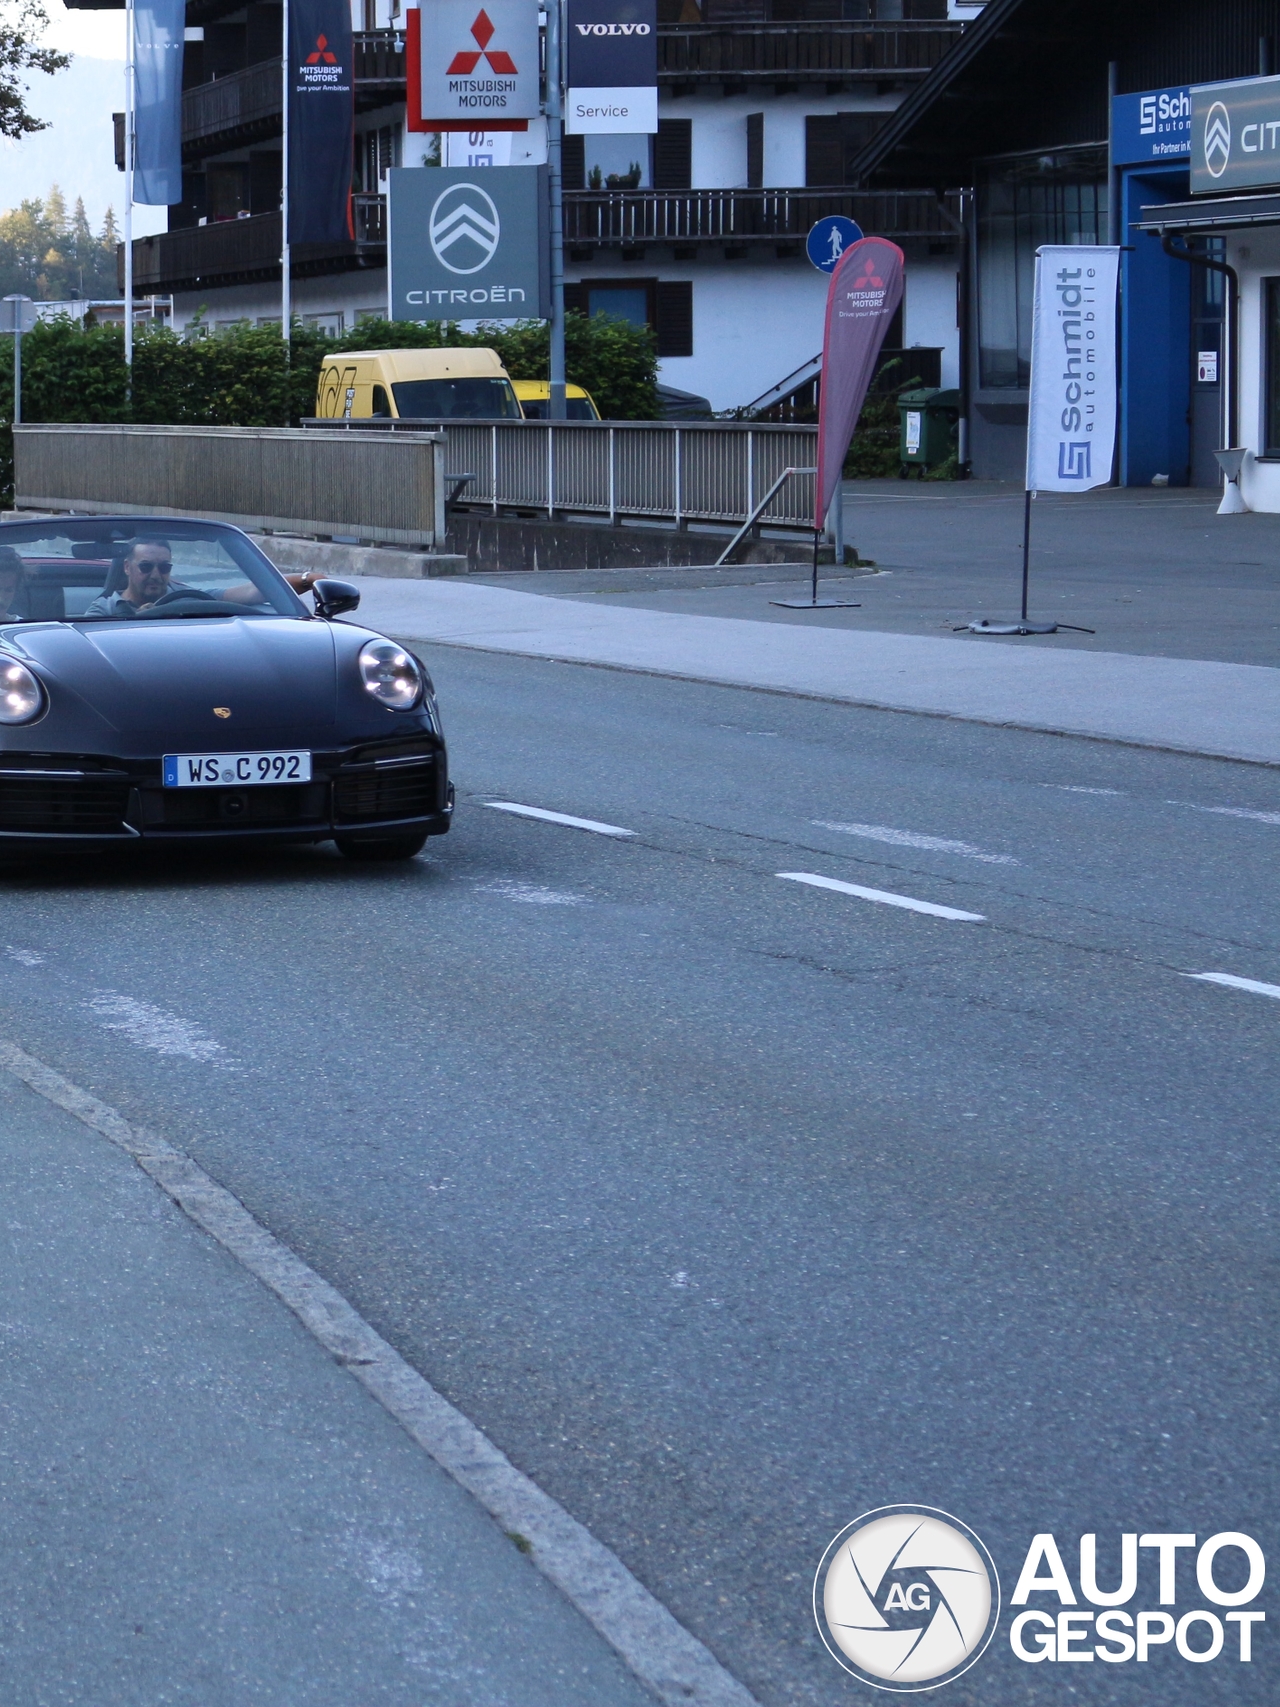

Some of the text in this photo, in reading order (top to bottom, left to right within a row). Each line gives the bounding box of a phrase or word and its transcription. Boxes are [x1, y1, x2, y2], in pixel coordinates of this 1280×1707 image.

[575, 23, 651, 36] VOLVO
[299, 66, 343, 74] MITSUBISHI
[448, 80, 517, 92] MITSUBISHI
[458, 95, 508, 107] MOTORS
[1158, 92, 1192, 119] Sch
[575, 105, 629, 118] Service
[1152, 143, 1160, 155] Ihr
[1160, 142, 1180, 154] Partner
[1180, 140, 1187, 152] in
[852, 299, 884, 308] MOTORS
[1056, 267, 1082, 433] Schmidt
[1084, 268, 1096, 432] automobile
[188, 758, 220, 783] WS
[236, 757, 252, 781] C
[257, 755, 301, 780] 992
